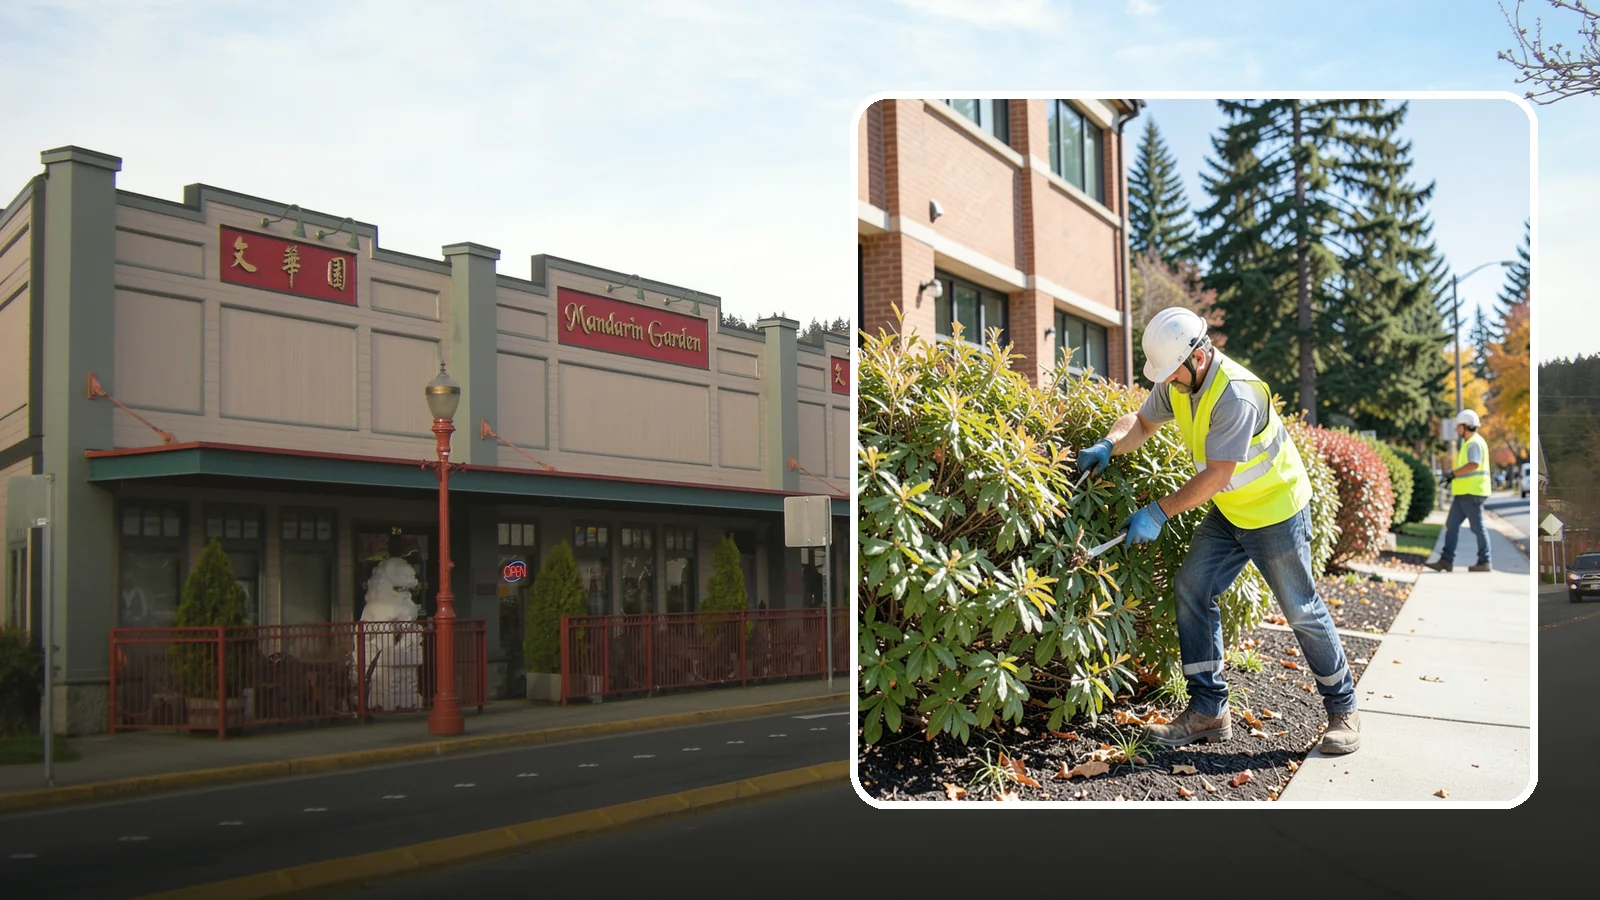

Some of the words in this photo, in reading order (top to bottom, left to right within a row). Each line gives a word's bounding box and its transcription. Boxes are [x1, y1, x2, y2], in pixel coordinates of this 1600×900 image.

[231, 236, 346, 291] 文華園
[564, 302, 644, 341] Mandarin
[648, 320, 701, 352] Garden
[503, 565, 527, 578] OPEN
